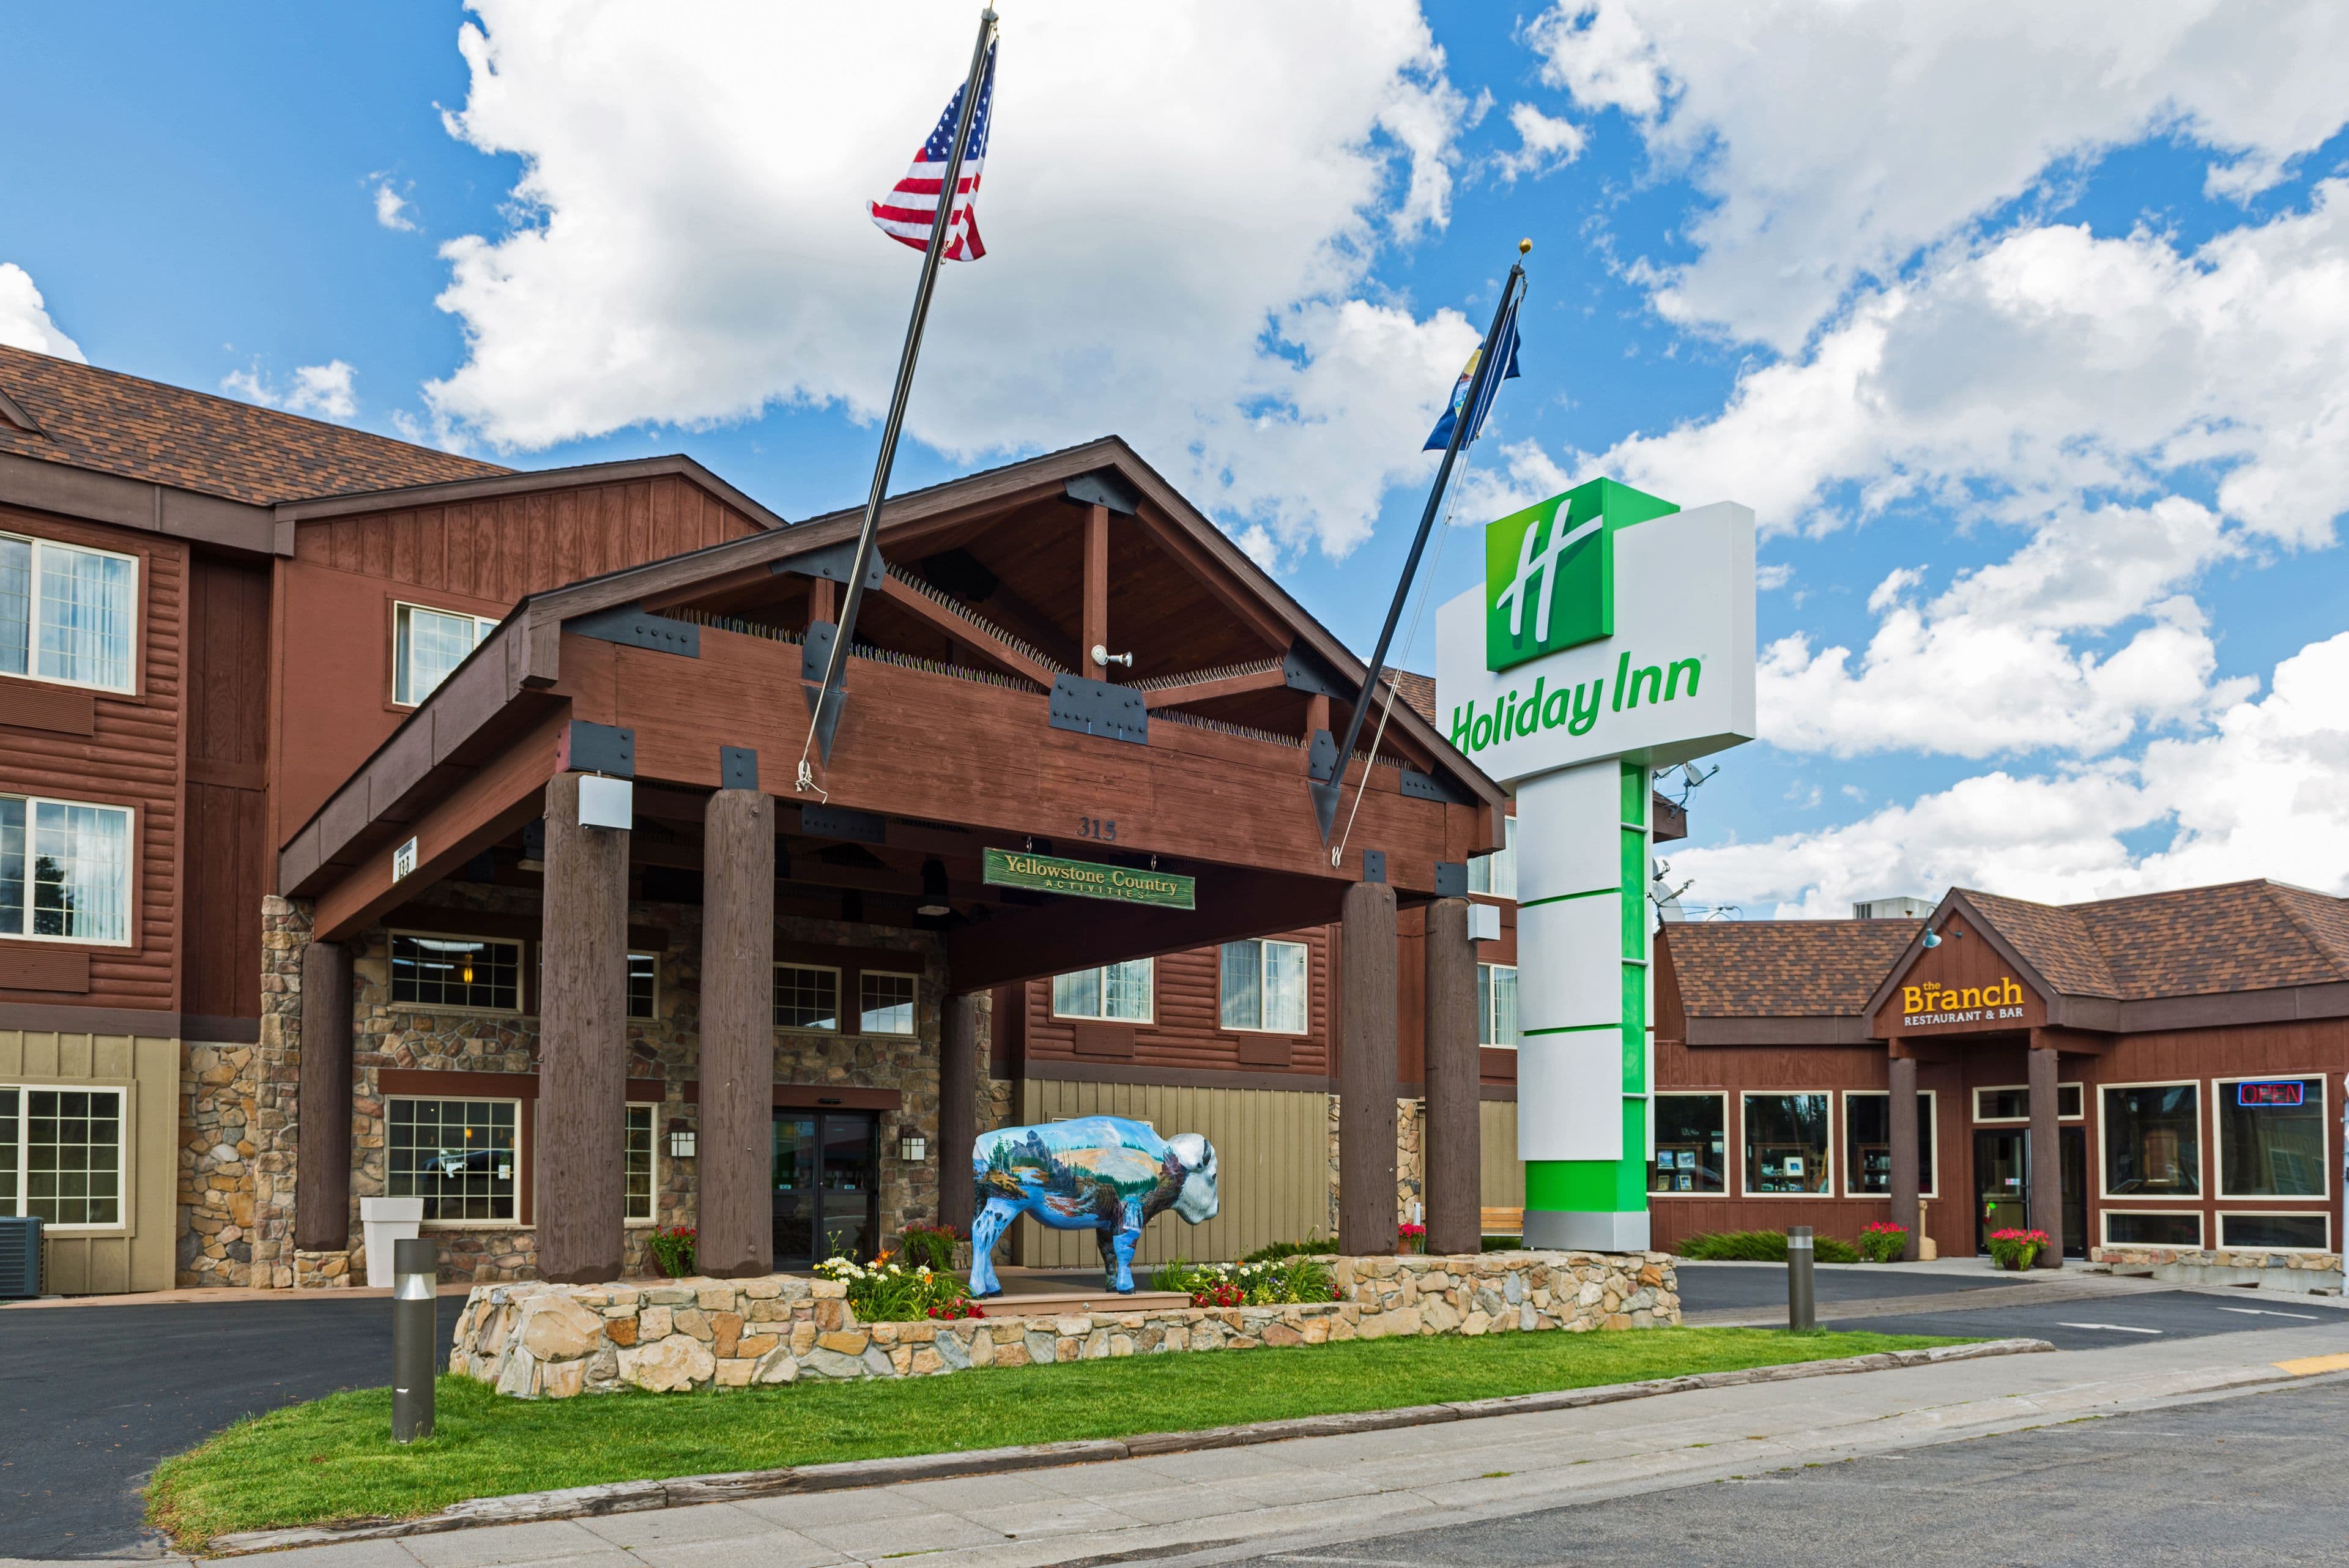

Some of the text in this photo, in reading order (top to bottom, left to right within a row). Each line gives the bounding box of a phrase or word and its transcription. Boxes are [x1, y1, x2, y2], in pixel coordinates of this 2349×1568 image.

[1449, 651, 1702, 756] Holiday Inn
[1077, 816, 1116, 841] 315
[1005, 855, 1178, 896] Yellowstone Country
[1046, 880, 1145, 899] ACTIVITIES
[1902, 977, 2024, 1014] Branch
[1923, 981, 1941, 990] the
[1904, 1008, 2024, 1027] RESTAURANT & BAR
[2241, 1084, 2302, 1104] OPEN
